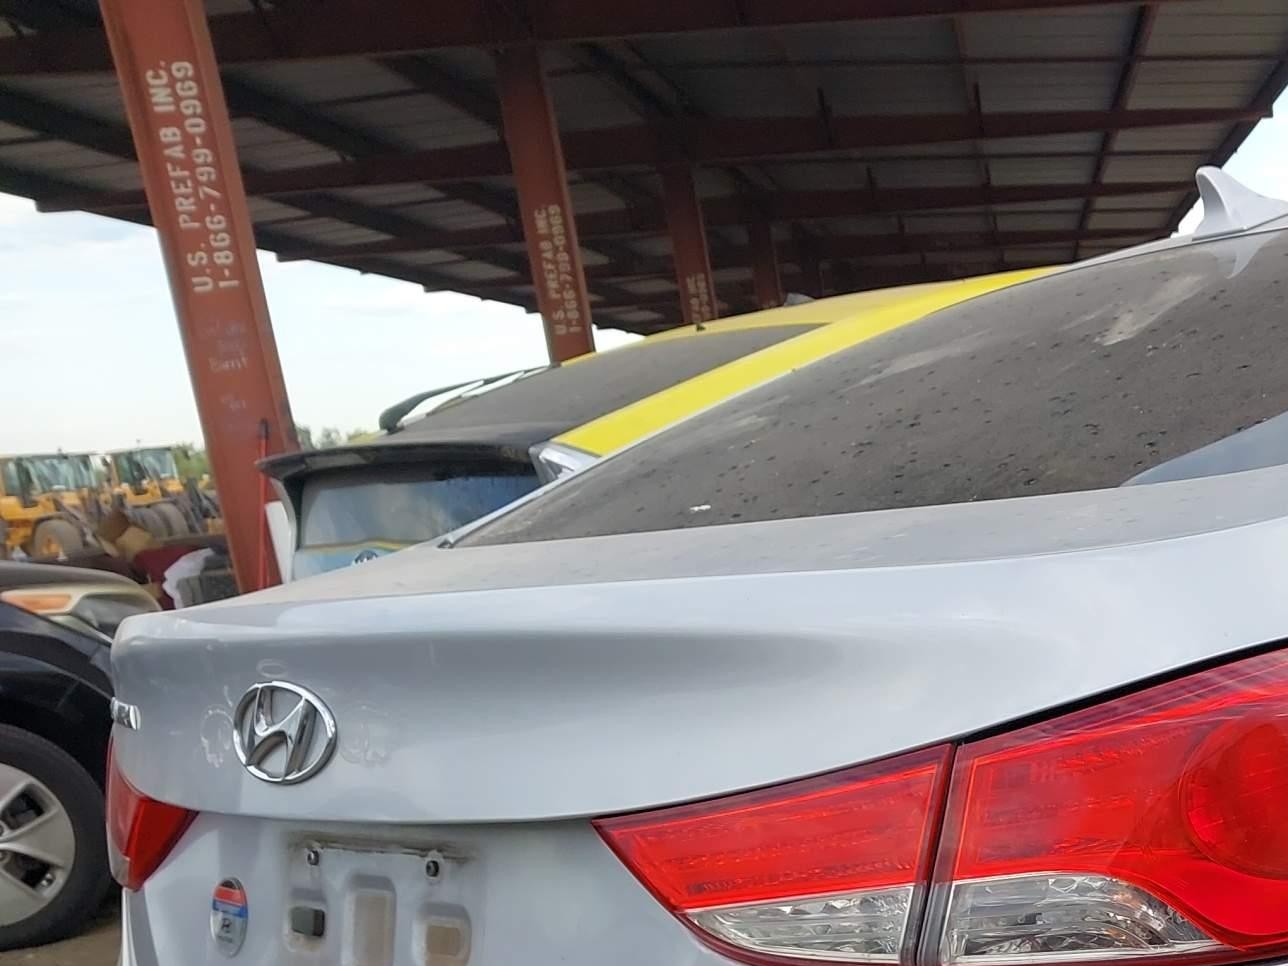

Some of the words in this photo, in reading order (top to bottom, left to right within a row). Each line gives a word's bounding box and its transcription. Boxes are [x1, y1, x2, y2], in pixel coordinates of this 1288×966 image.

[145, 60, 176, 112] INC.
[159, 126, 200, 229] PREFAB
[170, 61, 239, 288] 1-866-799-0969
[187, 241, 214, 293] U.S.
[539, 240, 561, 299] PREFAB
